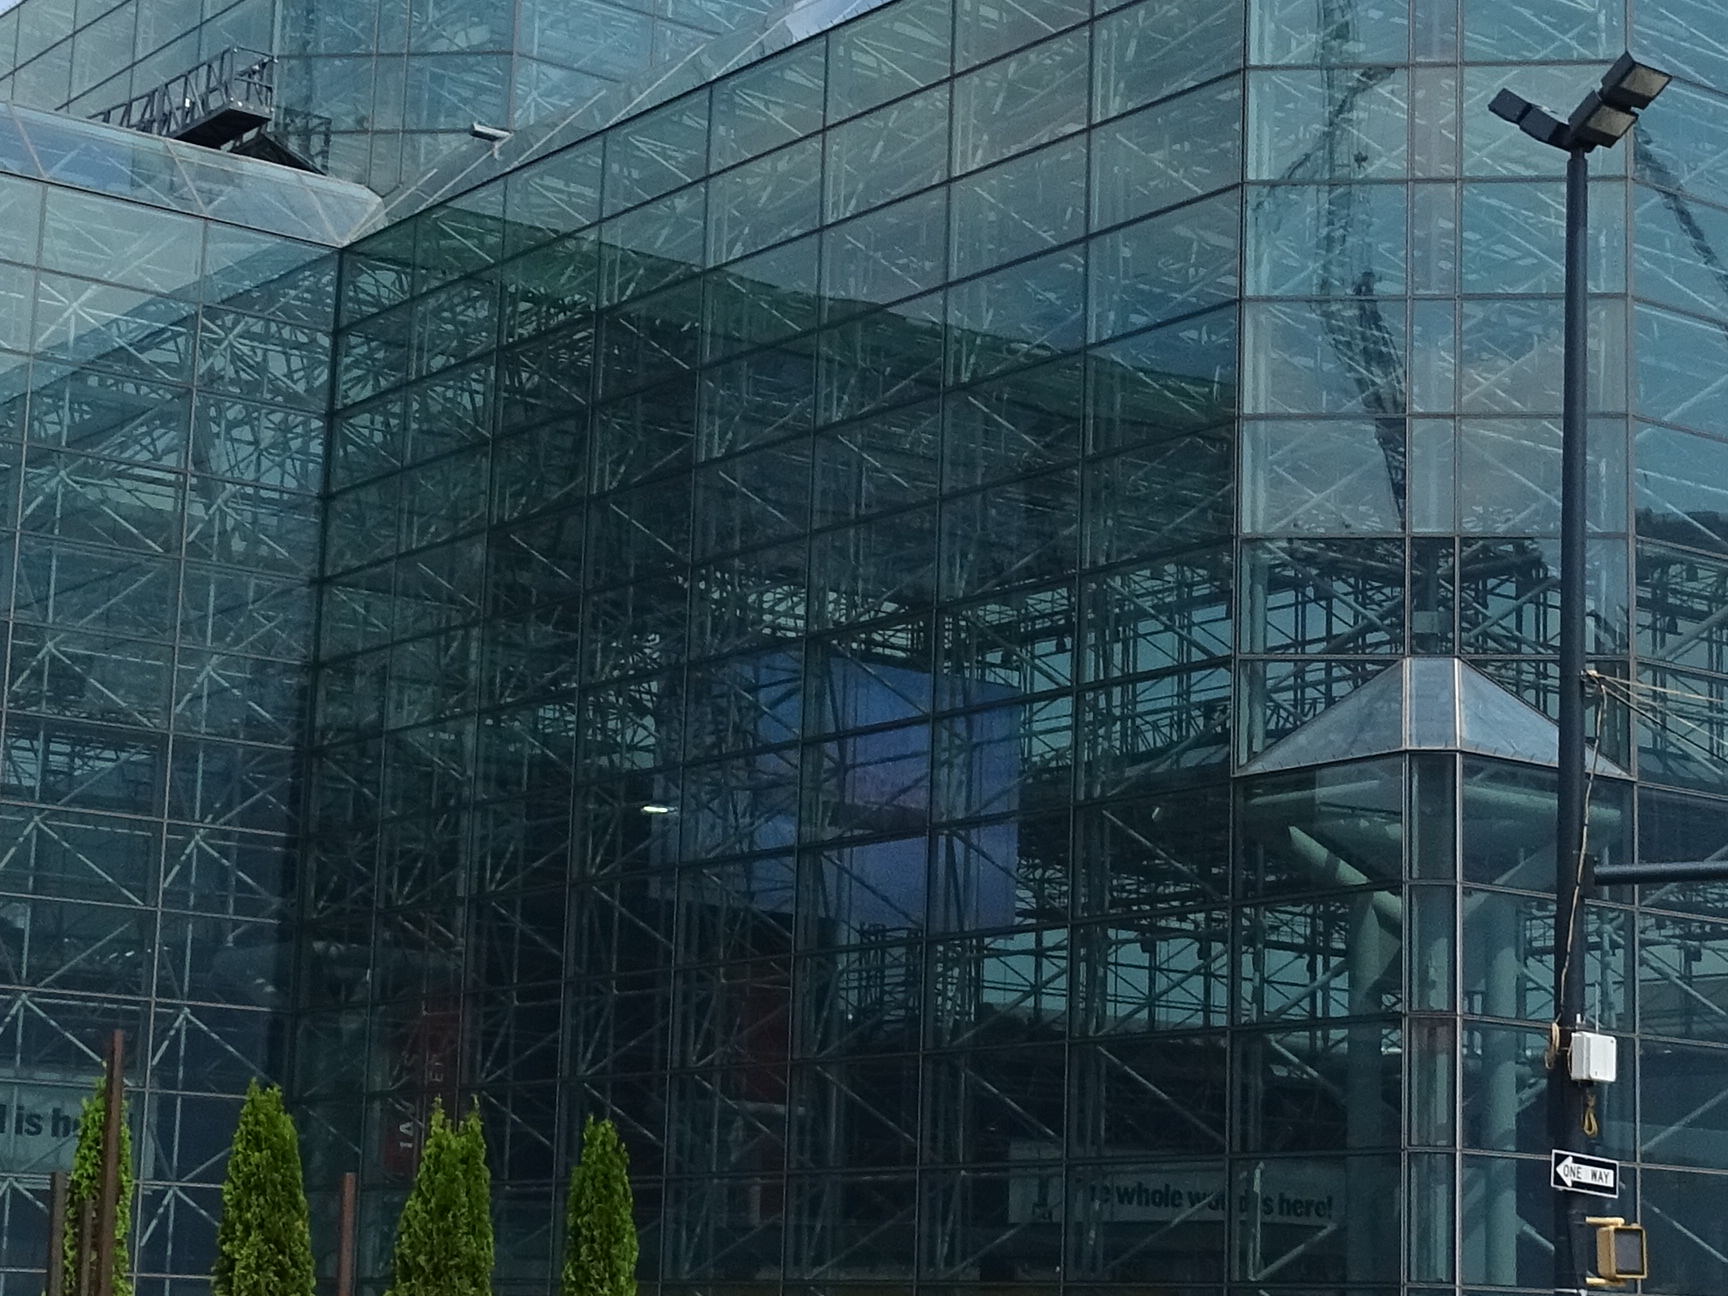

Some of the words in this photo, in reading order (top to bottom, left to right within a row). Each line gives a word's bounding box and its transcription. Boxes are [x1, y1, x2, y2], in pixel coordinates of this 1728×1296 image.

[14, 1105, 43, 1137] is
[1563, 1164, 1582, 1180] ONE
[1590, 1169, 1610, 1184] WAY
[1116, 1182, 1181, 1208] whole
[1279, 1192, 1332, 1219] here!
